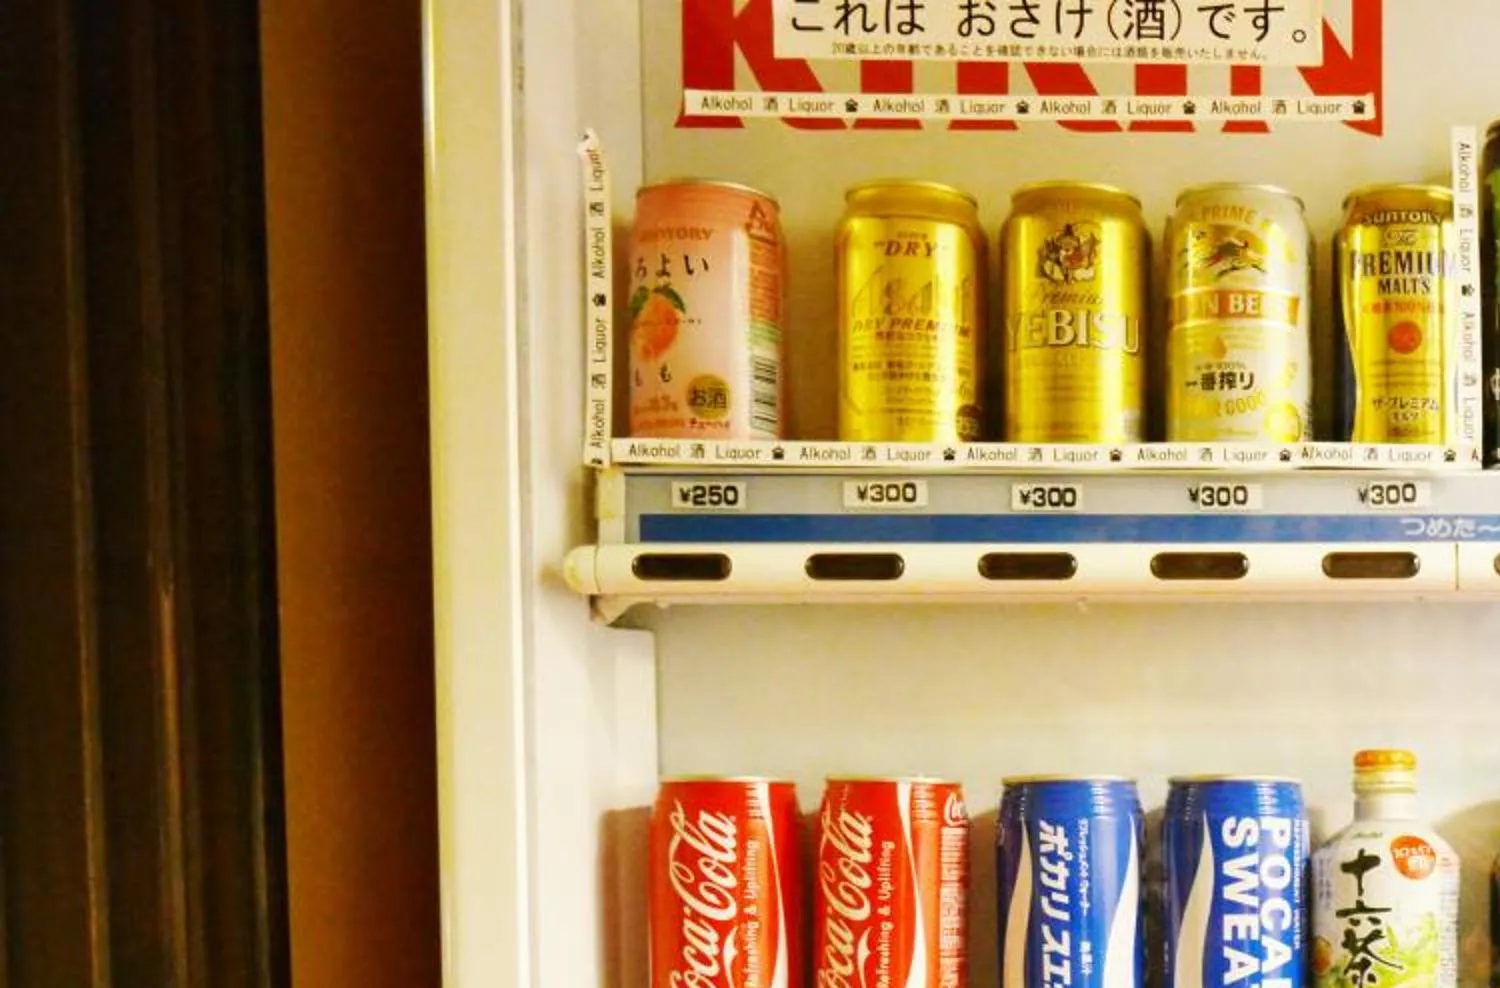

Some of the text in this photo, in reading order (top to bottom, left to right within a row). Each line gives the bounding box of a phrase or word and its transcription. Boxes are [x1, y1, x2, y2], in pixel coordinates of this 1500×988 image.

[680, 484, 739, 506] ¥250
[856, 482, 917, 503] ¥300
[1019, 486, 1077, 507] ¥300
[1188, 485, 1249, 507] ¥300
[1358, 482, 1417, 505] ¥300
